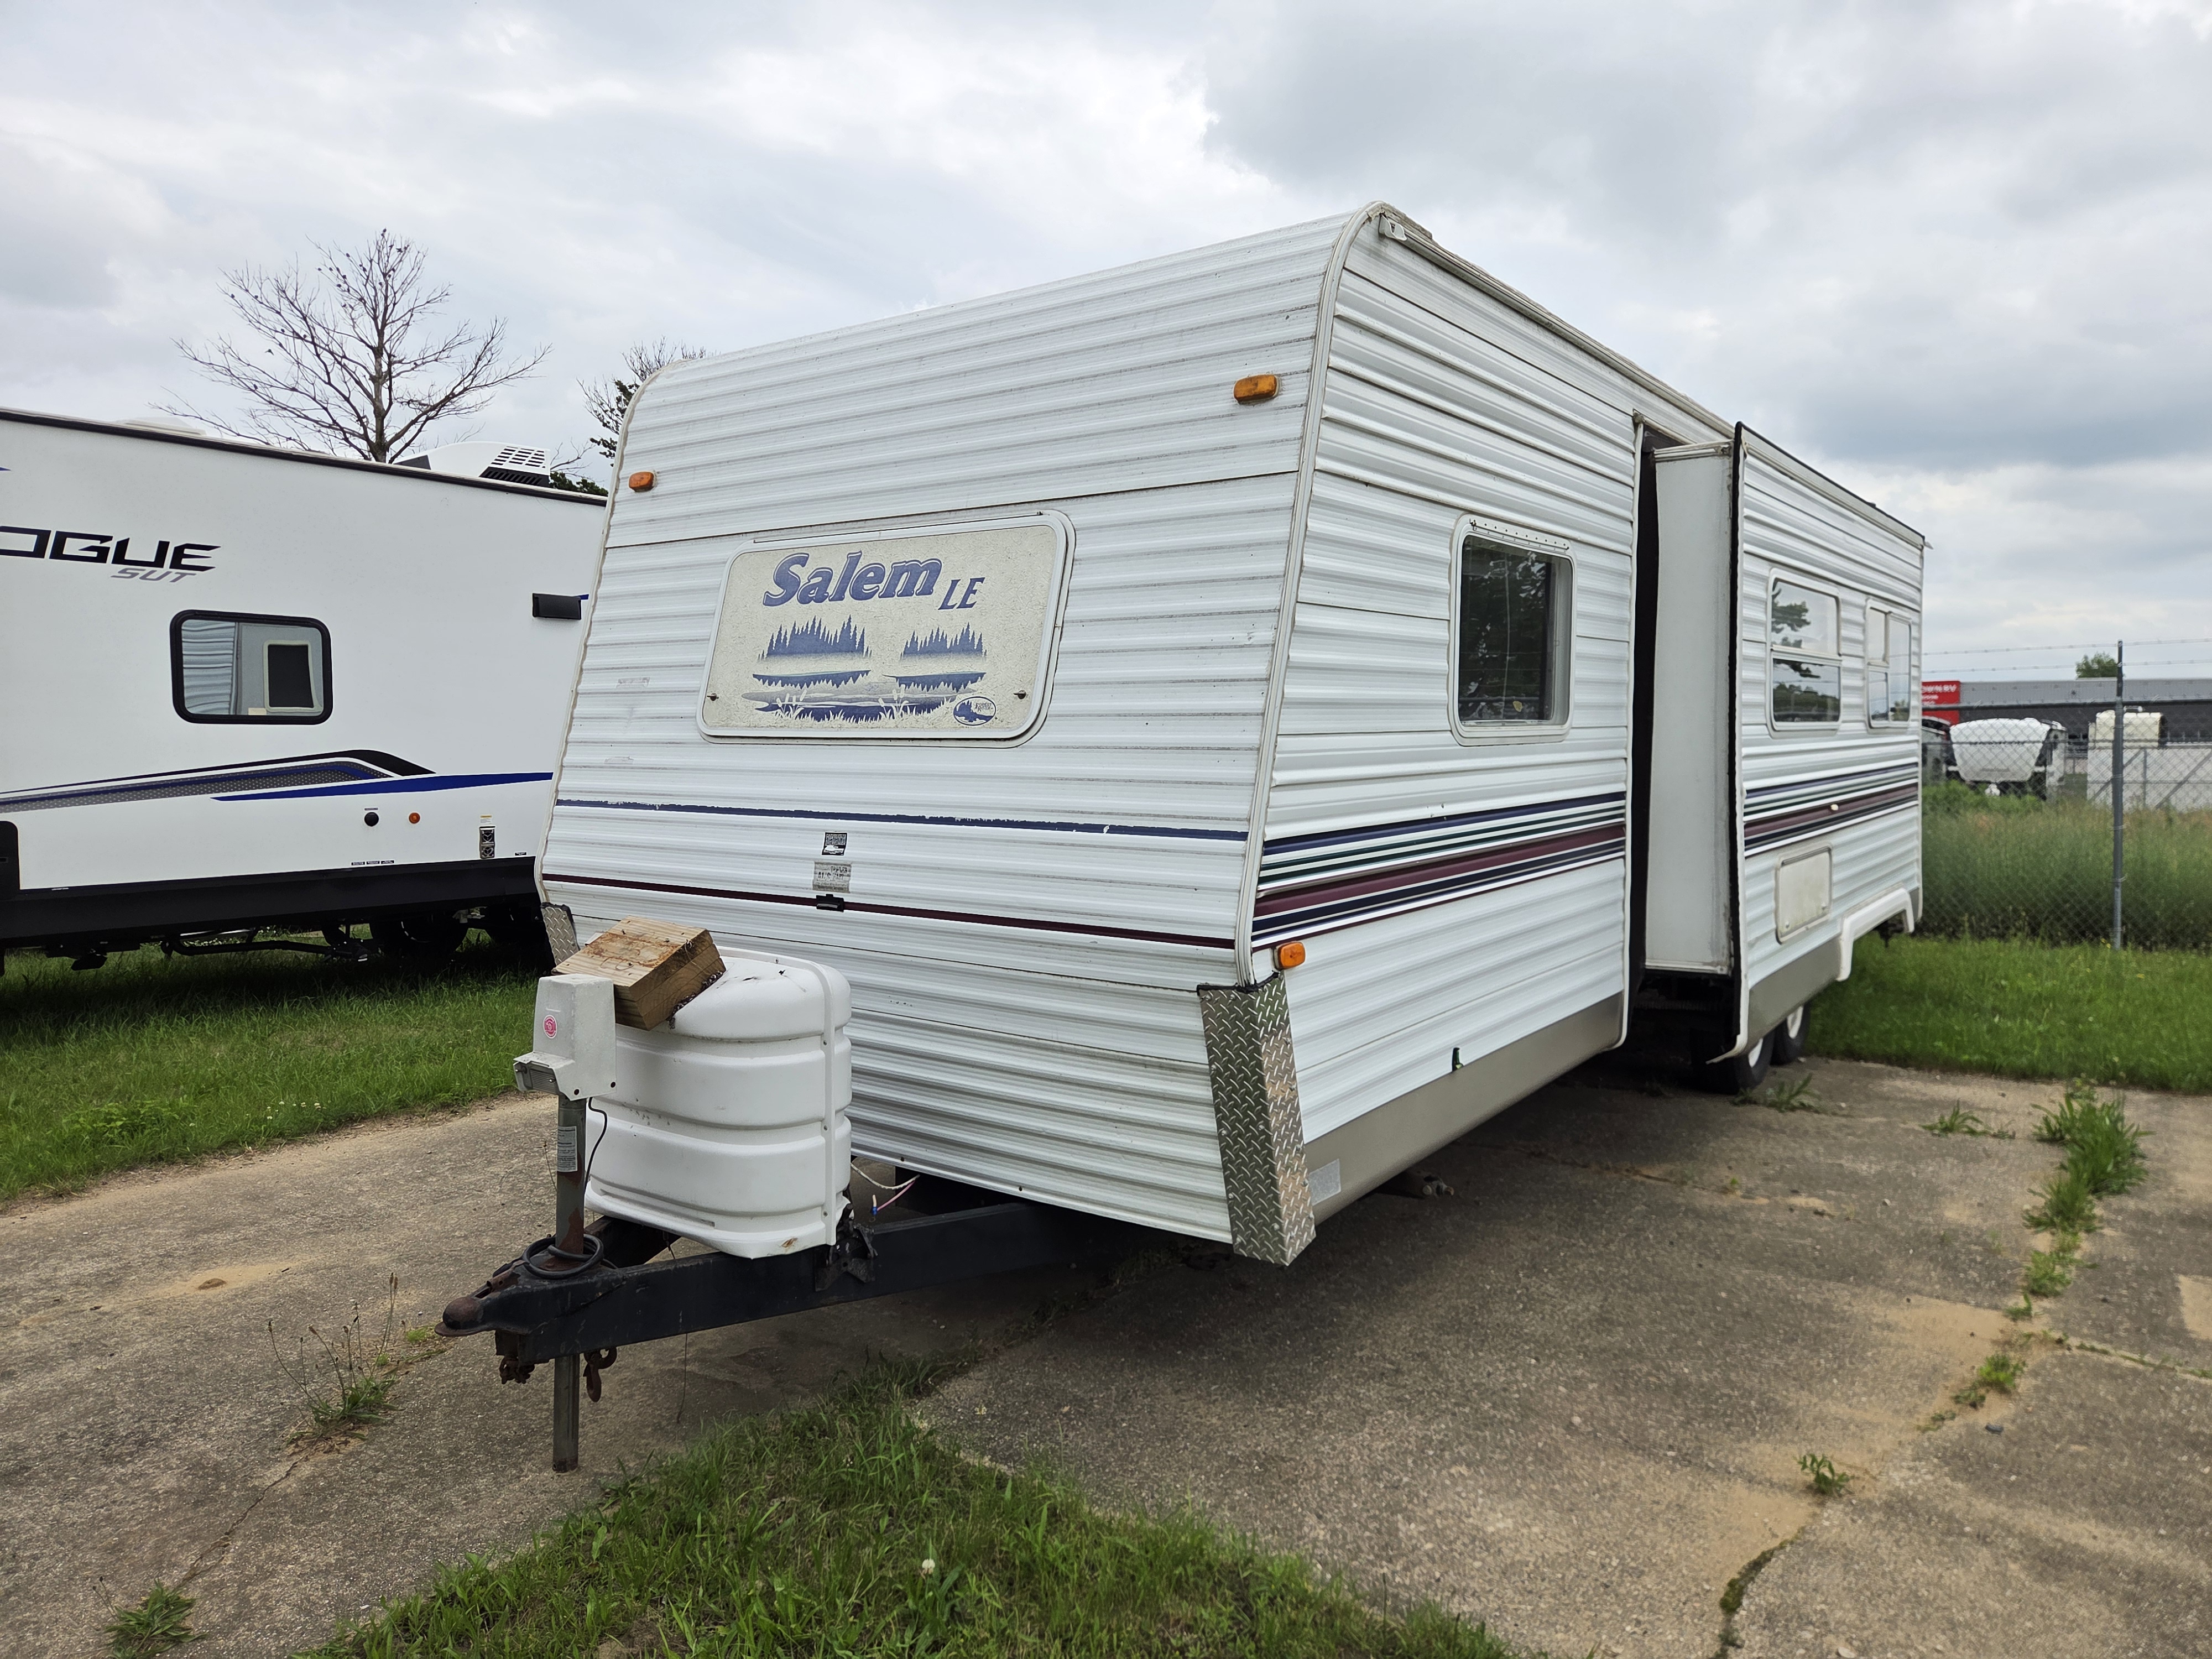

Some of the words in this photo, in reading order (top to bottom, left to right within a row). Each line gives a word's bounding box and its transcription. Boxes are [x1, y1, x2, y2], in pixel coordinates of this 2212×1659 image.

[111, 568, 196, 583] SUT
[763, 550, 942, 607] Salem
[938, 577, 985, 610] LE
